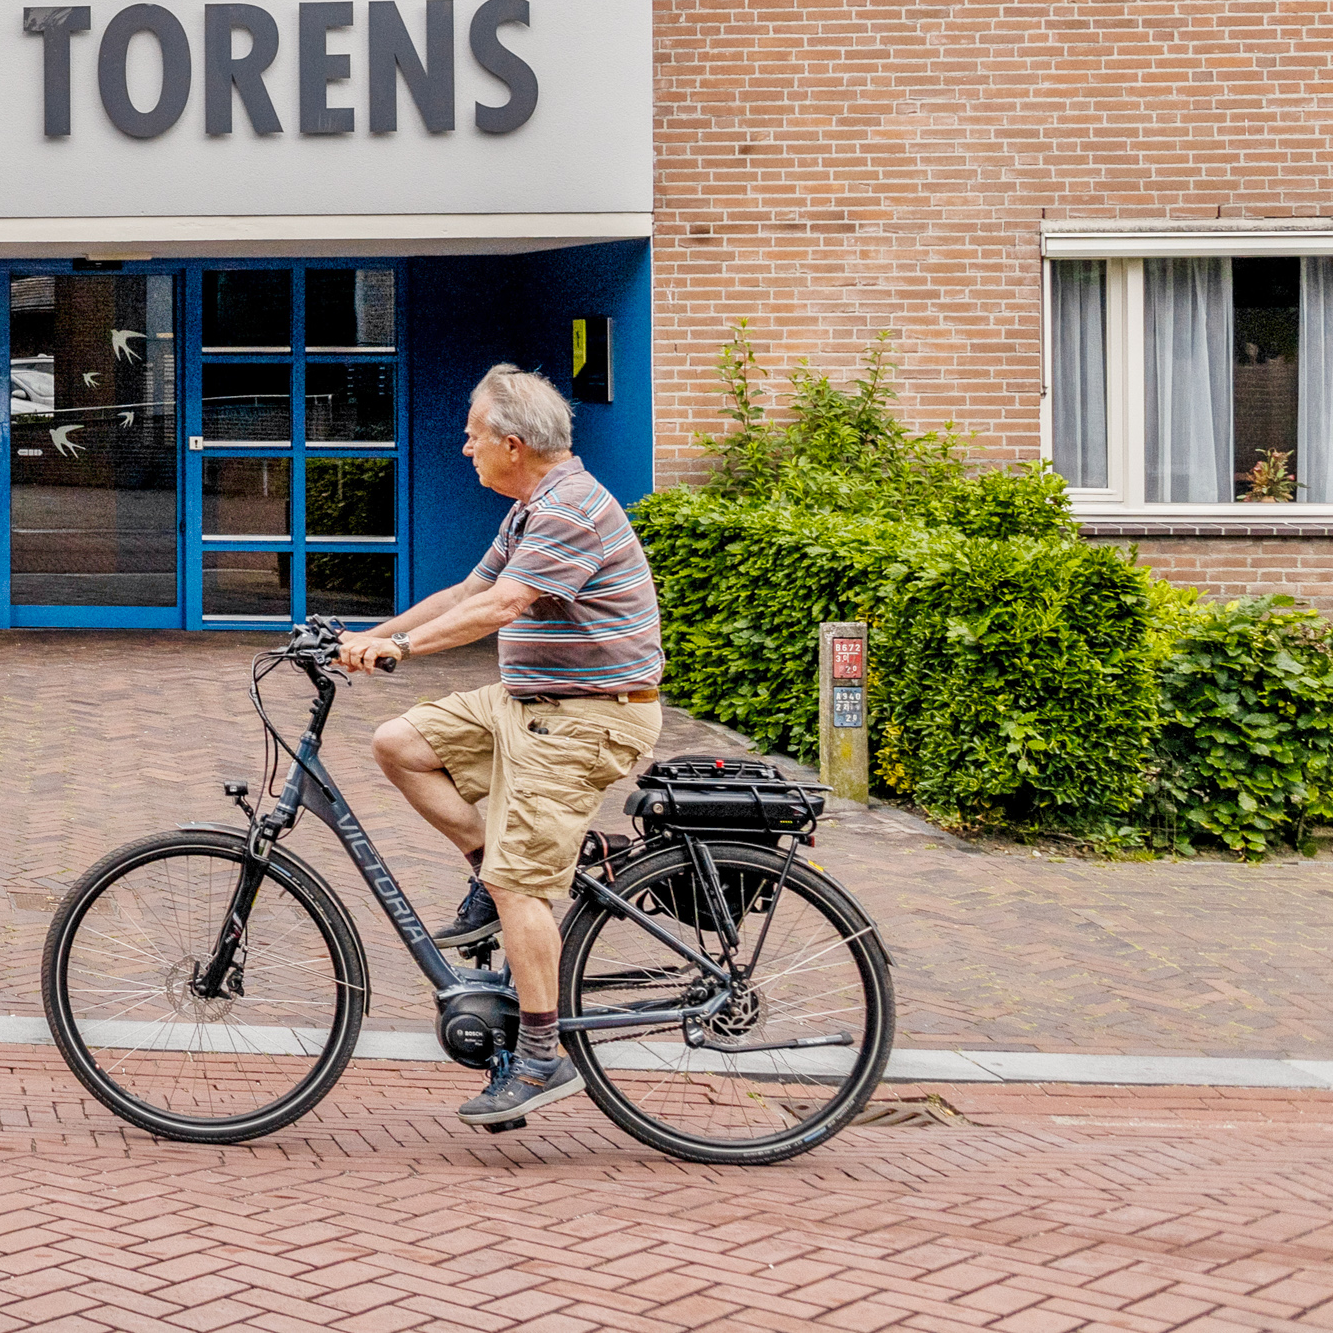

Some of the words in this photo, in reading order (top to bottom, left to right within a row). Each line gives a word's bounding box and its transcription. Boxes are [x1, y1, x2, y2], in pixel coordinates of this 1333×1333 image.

[835, 643, 861, 652] B672
[845, 665, 858, 674] 2.0
[336, 813, 429, 944] VICTORIA
